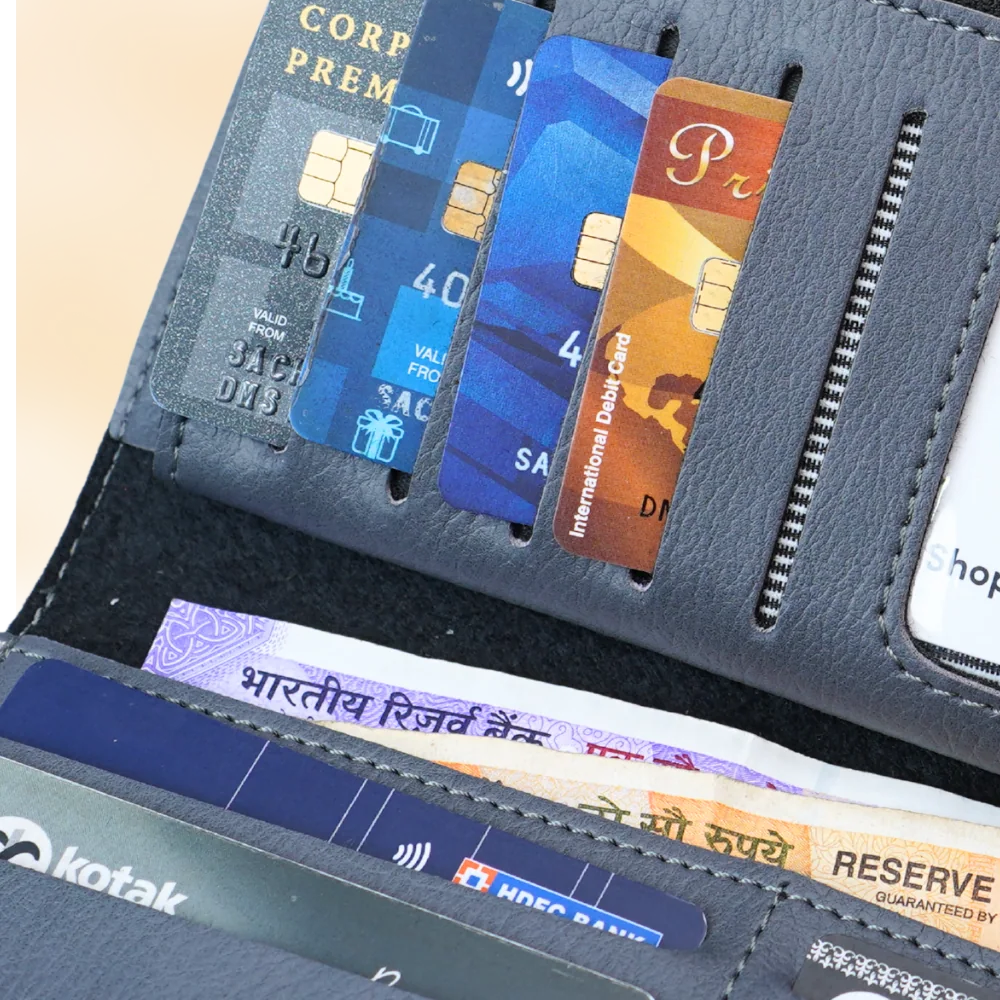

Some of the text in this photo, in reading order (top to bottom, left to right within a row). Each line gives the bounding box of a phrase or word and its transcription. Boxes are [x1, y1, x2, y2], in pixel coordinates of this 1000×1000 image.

[299, 4, 411, 57] CORP
[283, 47, 398, 105] PREM
[275, 222, 329, 278] 46
[412, 263, 469, 309] 40
[249, 323, 286, 342] FROM
[253, 307, 288, 327] VALID
[558, 330, 583, 368] 4
[215, 375, 280, 416] DMS
[569, 332, 631, 538] International Debit Card
[514, 447, 549, 476] SA
[241, 666, 374, 721] भारतीय
[52, 846, 188, 916] kotak
[832, 850, 995, 904] RESERVE
[875, 891, 974, 919] GUARANTEED
[977, 910, 998, 925] BY
